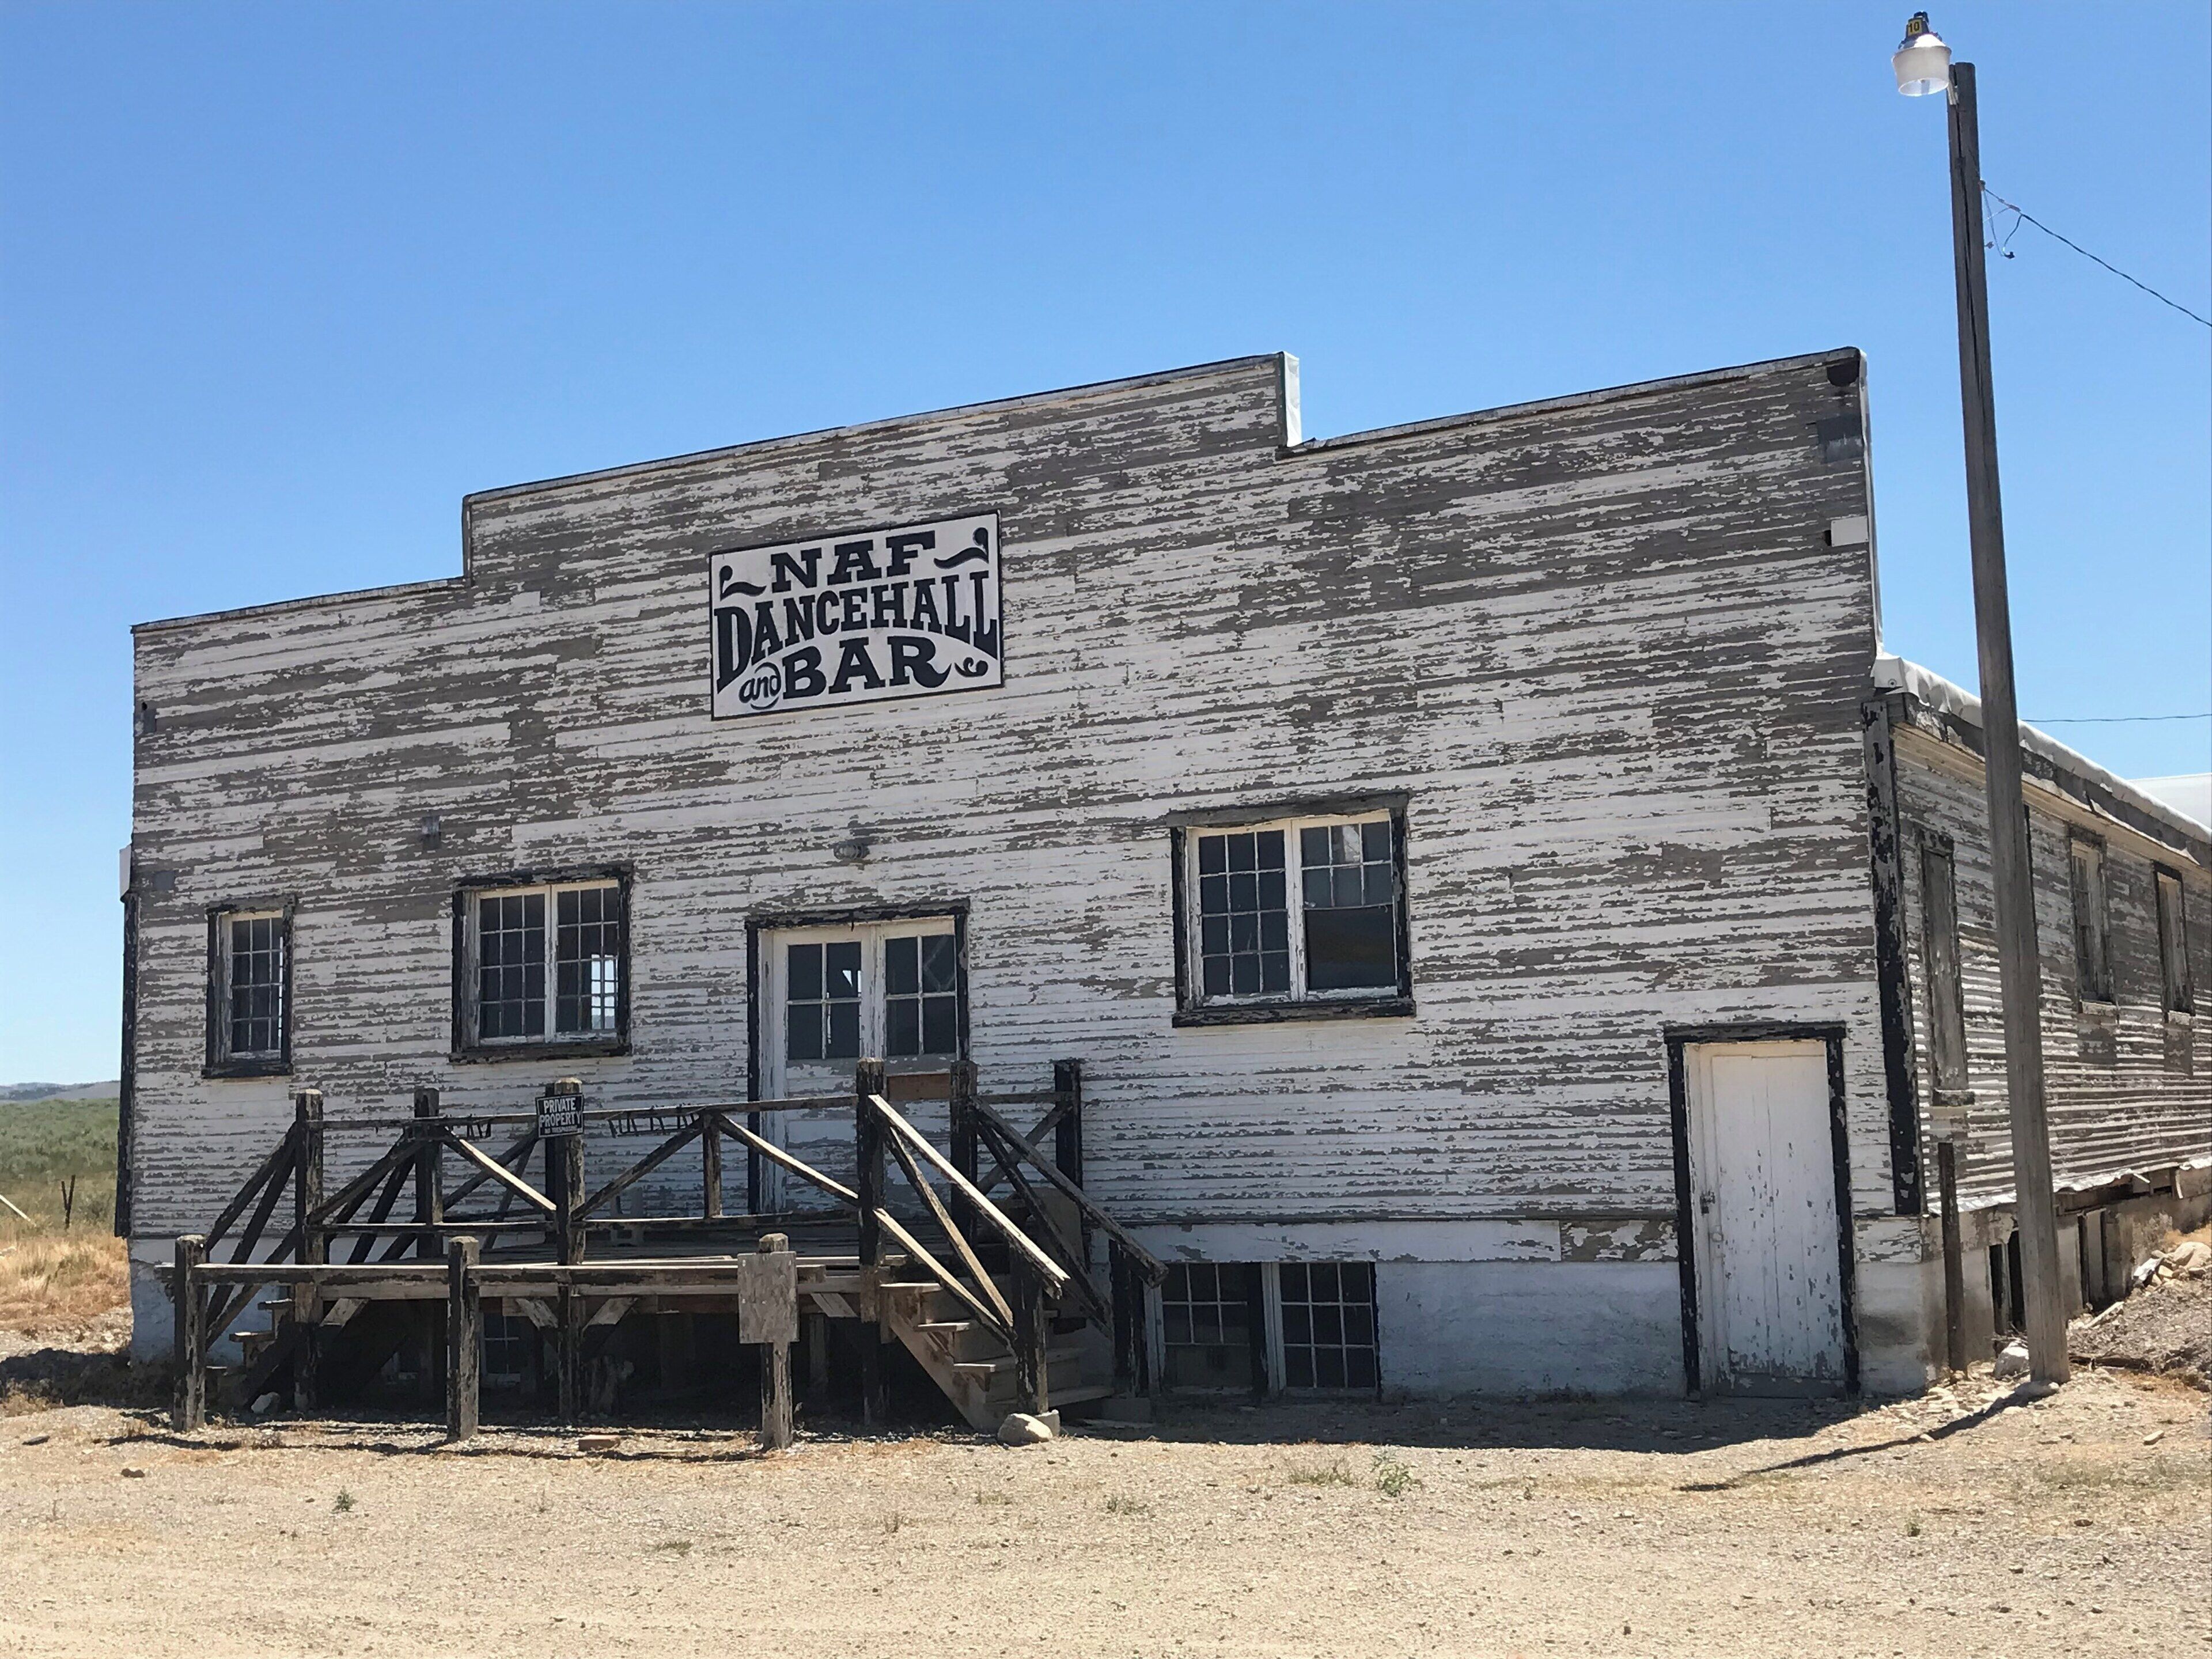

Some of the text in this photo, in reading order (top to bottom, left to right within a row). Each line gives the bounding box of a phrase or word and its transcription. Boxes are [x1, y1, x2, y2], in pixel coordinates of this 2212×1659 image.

[1908, 21, 1920, 33] 10
[770, 529, 935, 593] NAF
[714, 570, 998, 695] DANCEHALL
[738, 635, 952, 706] and BAR
[539, 1111, 581, 1127] PROPERTY
[544, 1097, 576, 1113] PRIVATE
